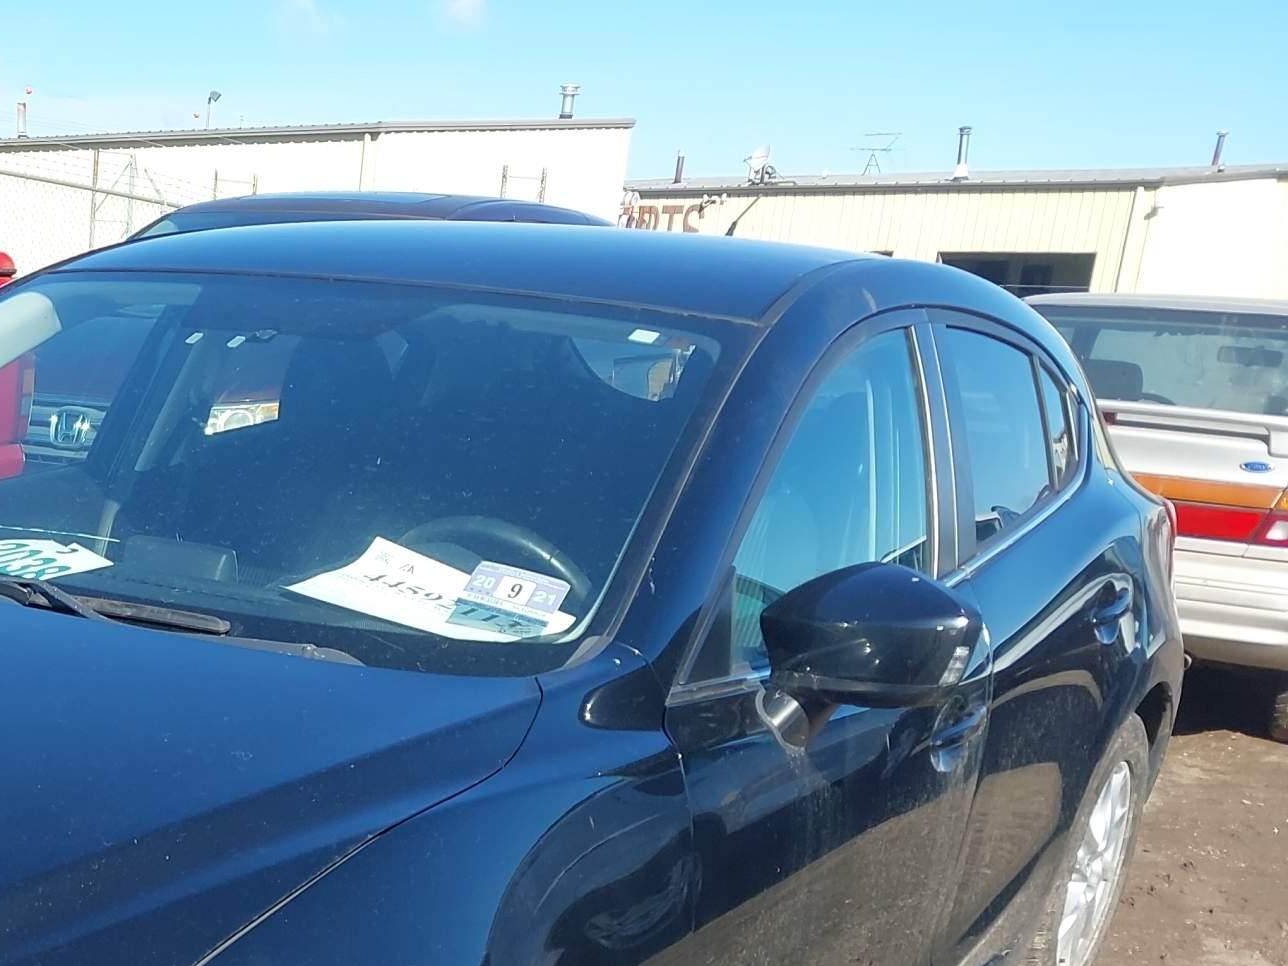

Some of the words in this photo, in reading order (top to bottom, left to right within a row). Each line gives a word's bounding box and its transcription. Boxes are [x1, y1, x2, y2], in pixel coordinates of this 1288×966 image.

[471, 574, 496, 589] 20
[507, 583, 523, 599] 9
[533, 590, 557, 606] 21
